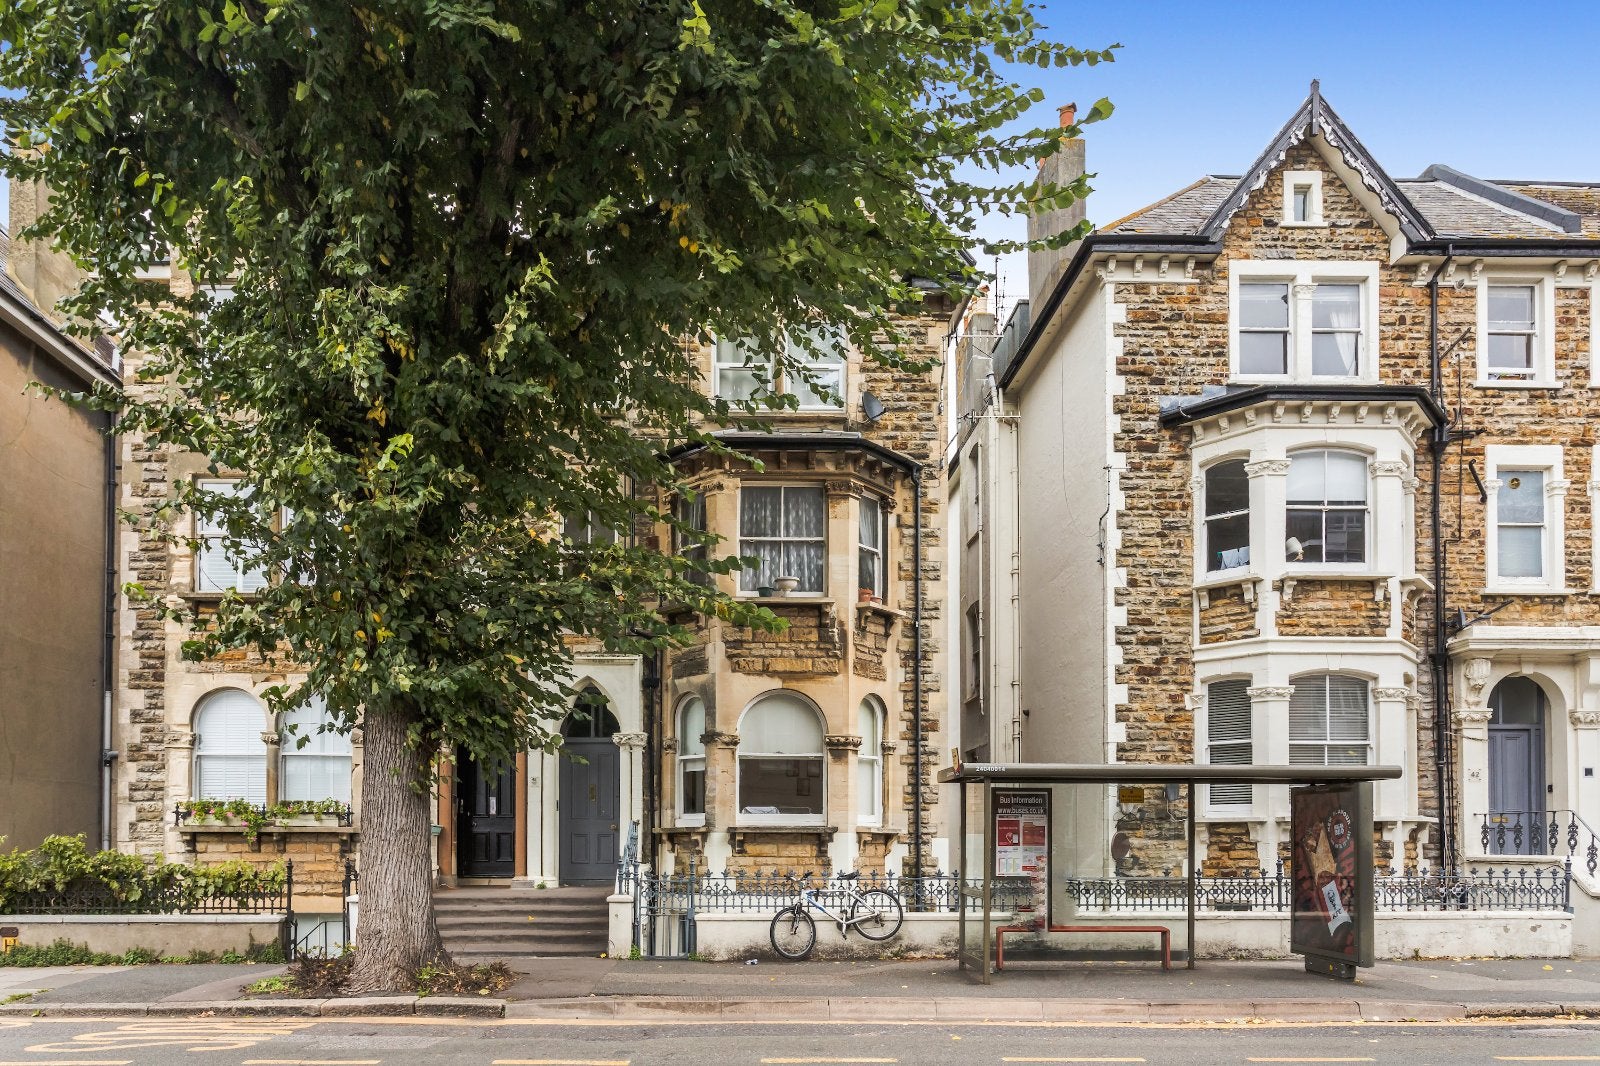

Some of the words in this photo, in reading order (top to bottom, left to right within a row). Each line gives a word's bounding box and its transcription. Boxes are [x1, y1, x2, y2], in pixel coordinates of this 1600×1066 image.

[1000, 796, 1010, 804] Bus
[1011, 796, 1042, 804] Information
[997, 806, 1044, 814] www.buses.co.uk
